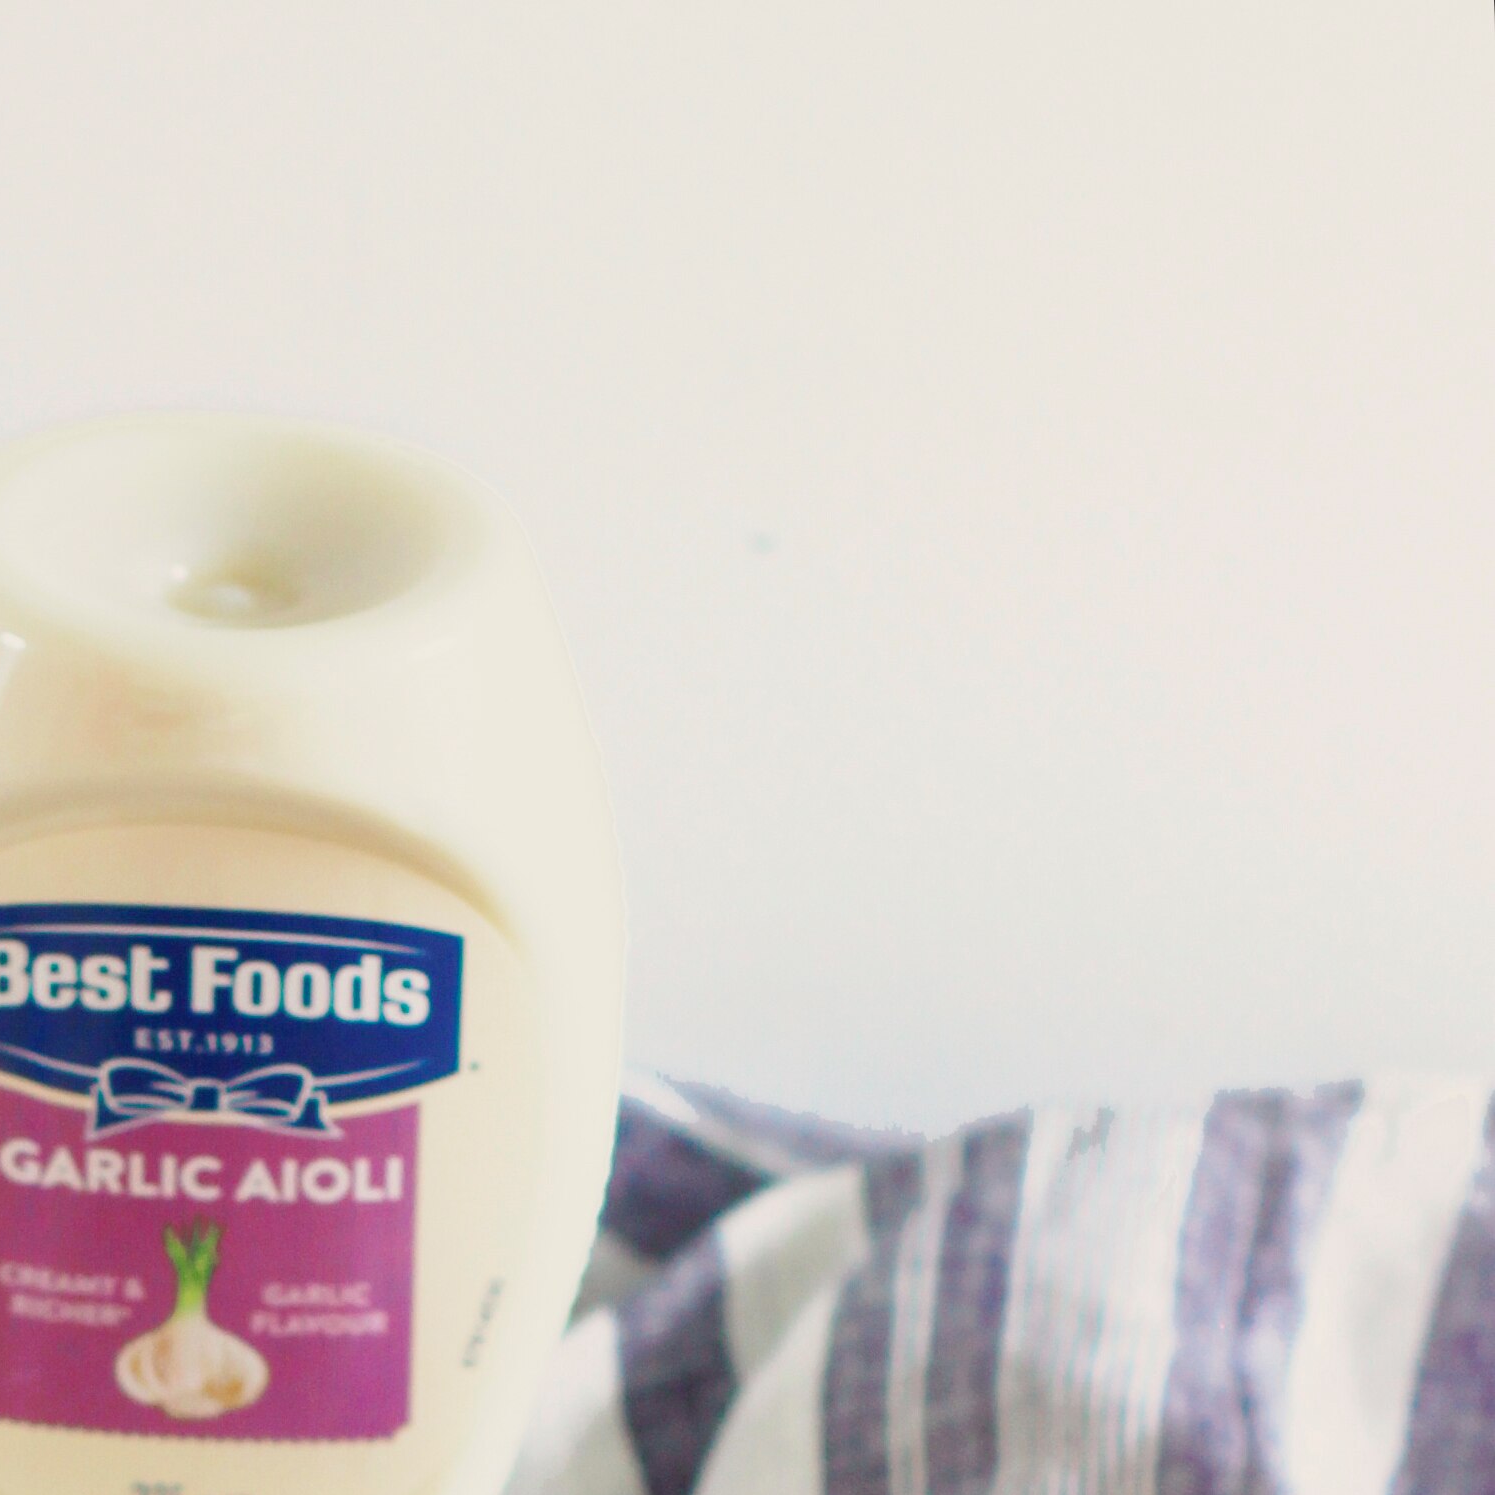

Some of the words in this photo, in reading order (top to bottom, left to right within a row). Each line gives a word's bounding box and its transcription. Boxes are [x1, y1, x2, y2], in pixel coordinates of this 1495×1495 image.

[191, 944, 431, 1027] Foods
[133, 1027, 275, 1056] EST.1913
[236, 1154, 404, 1203] AIOLI
